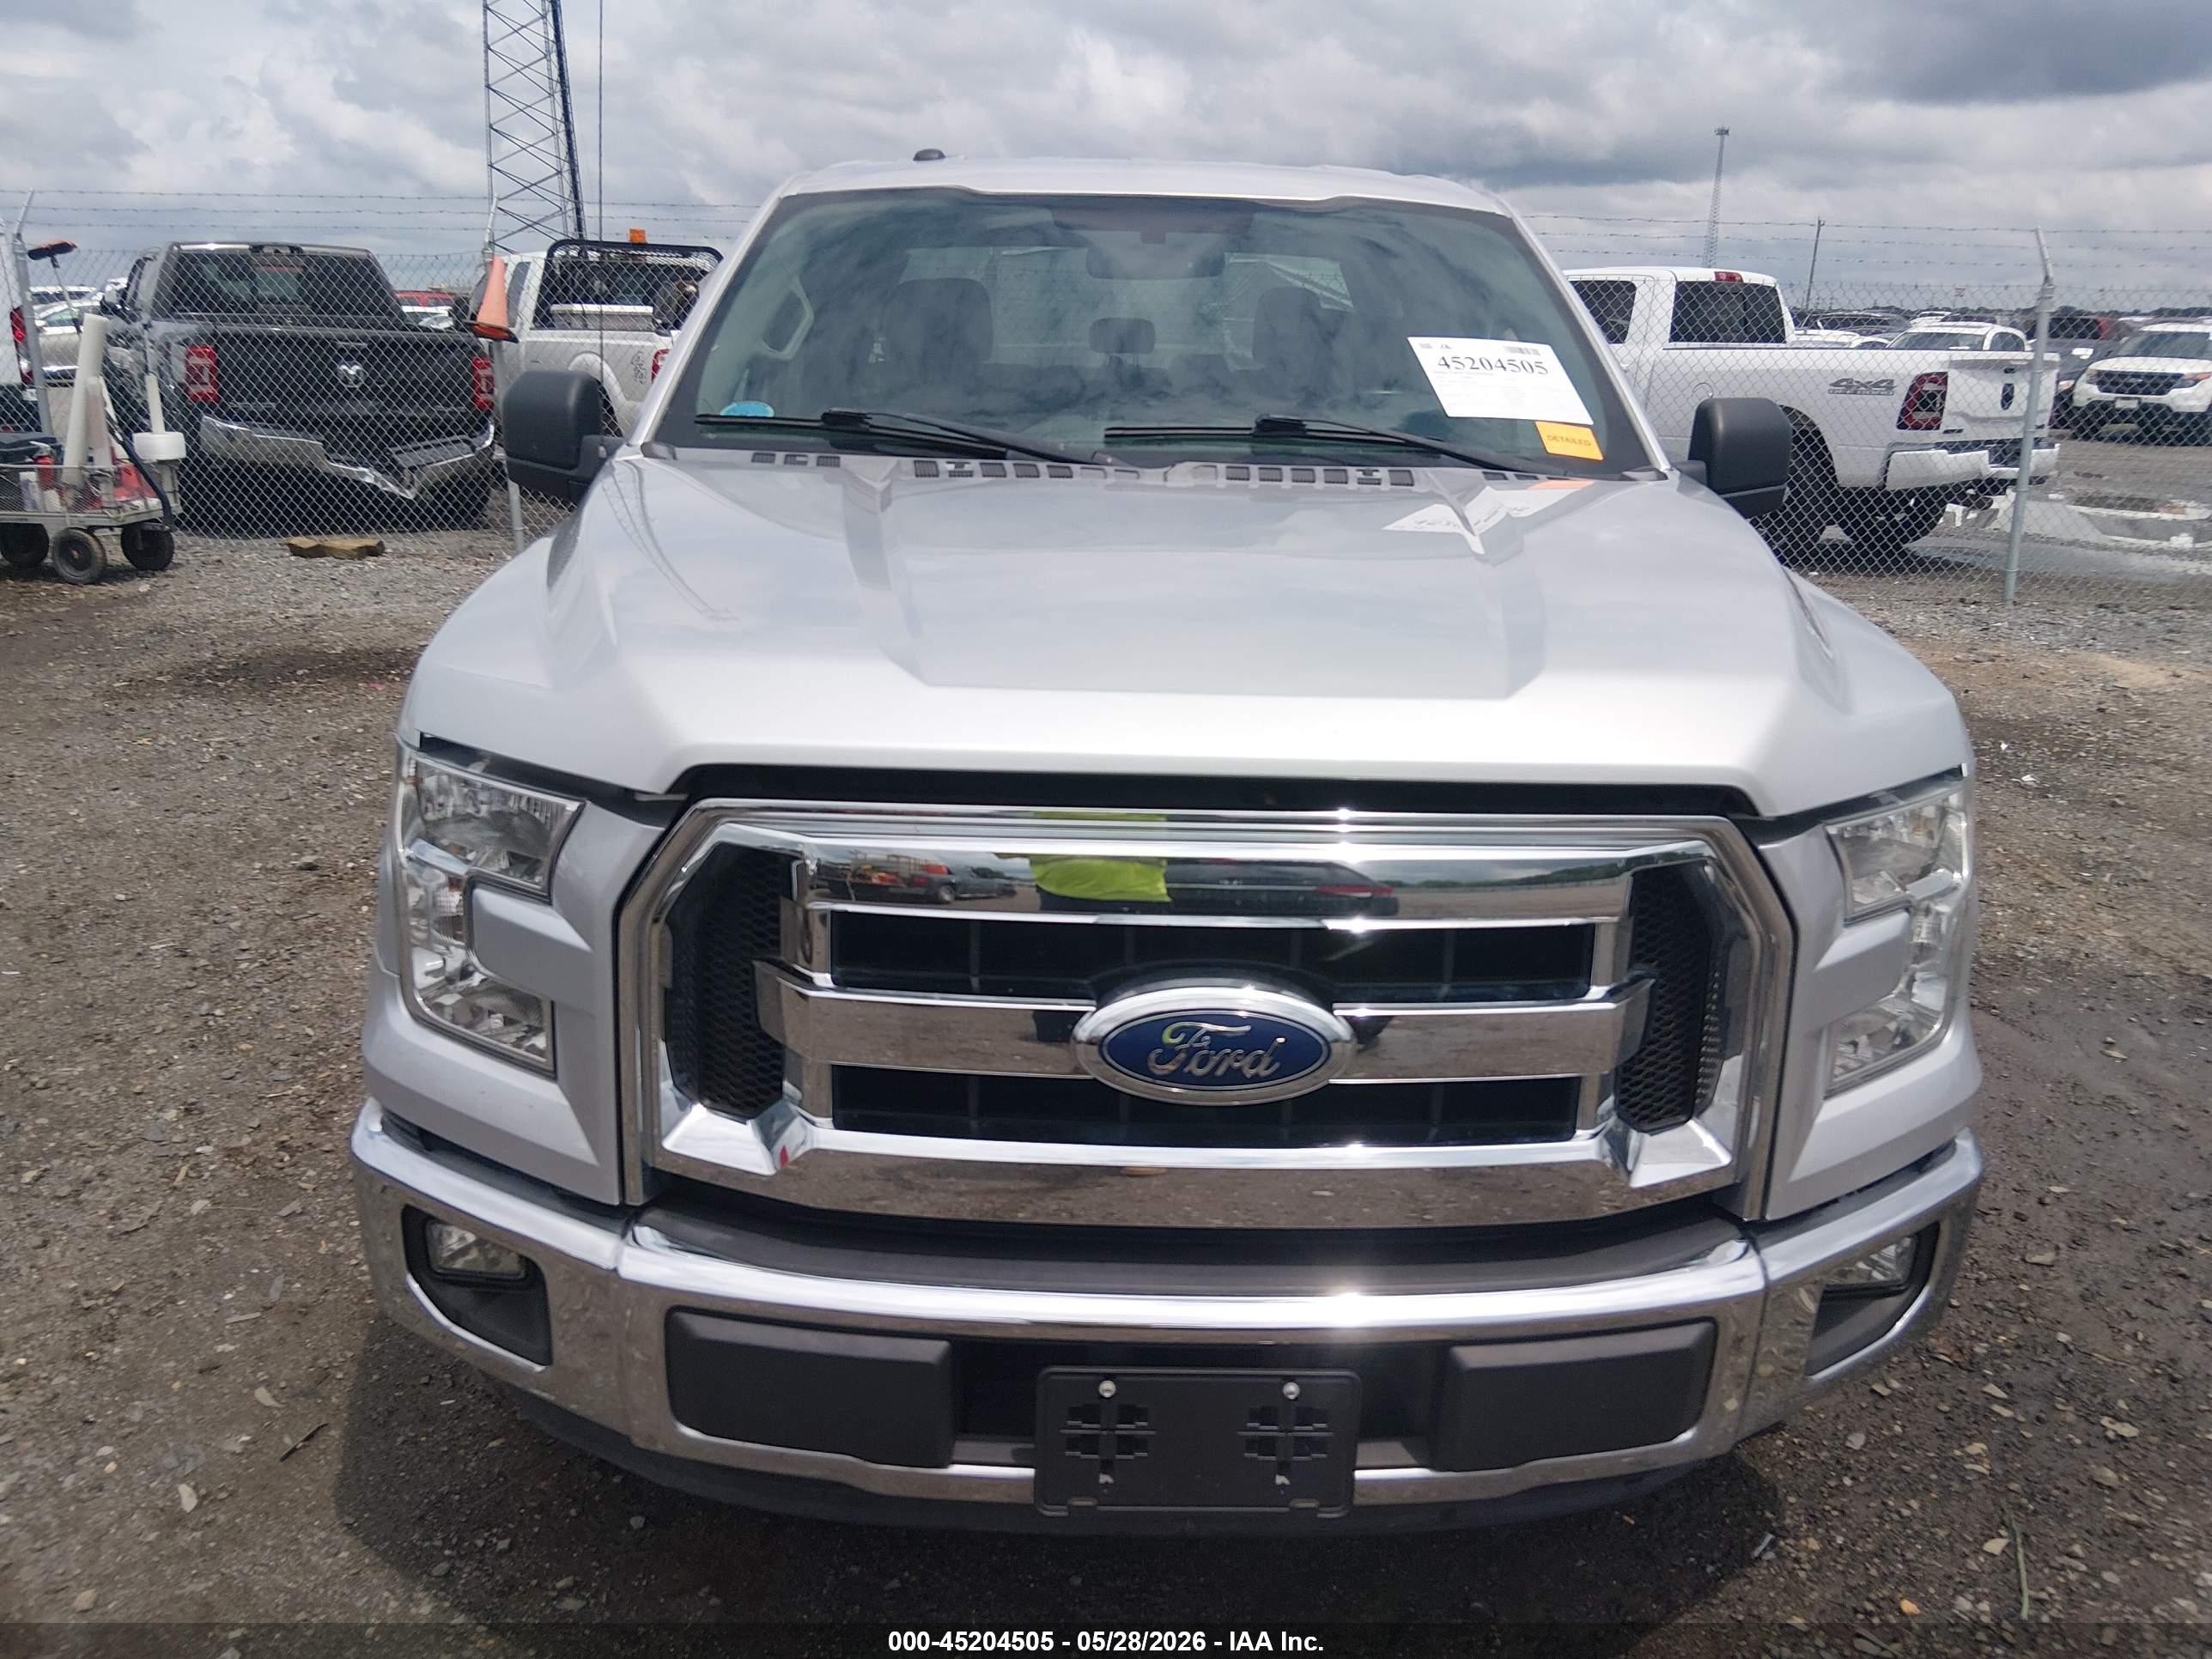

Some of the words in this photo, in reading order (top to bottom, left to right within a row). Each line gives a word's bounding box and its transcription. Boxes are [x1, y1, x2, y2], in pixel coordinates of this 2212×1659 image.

[1437, 356, 1549, 375] 45204505
[1547, 434, 1591, 447] DETAILED
[1147, 1021, 1285, 1079] Ford
